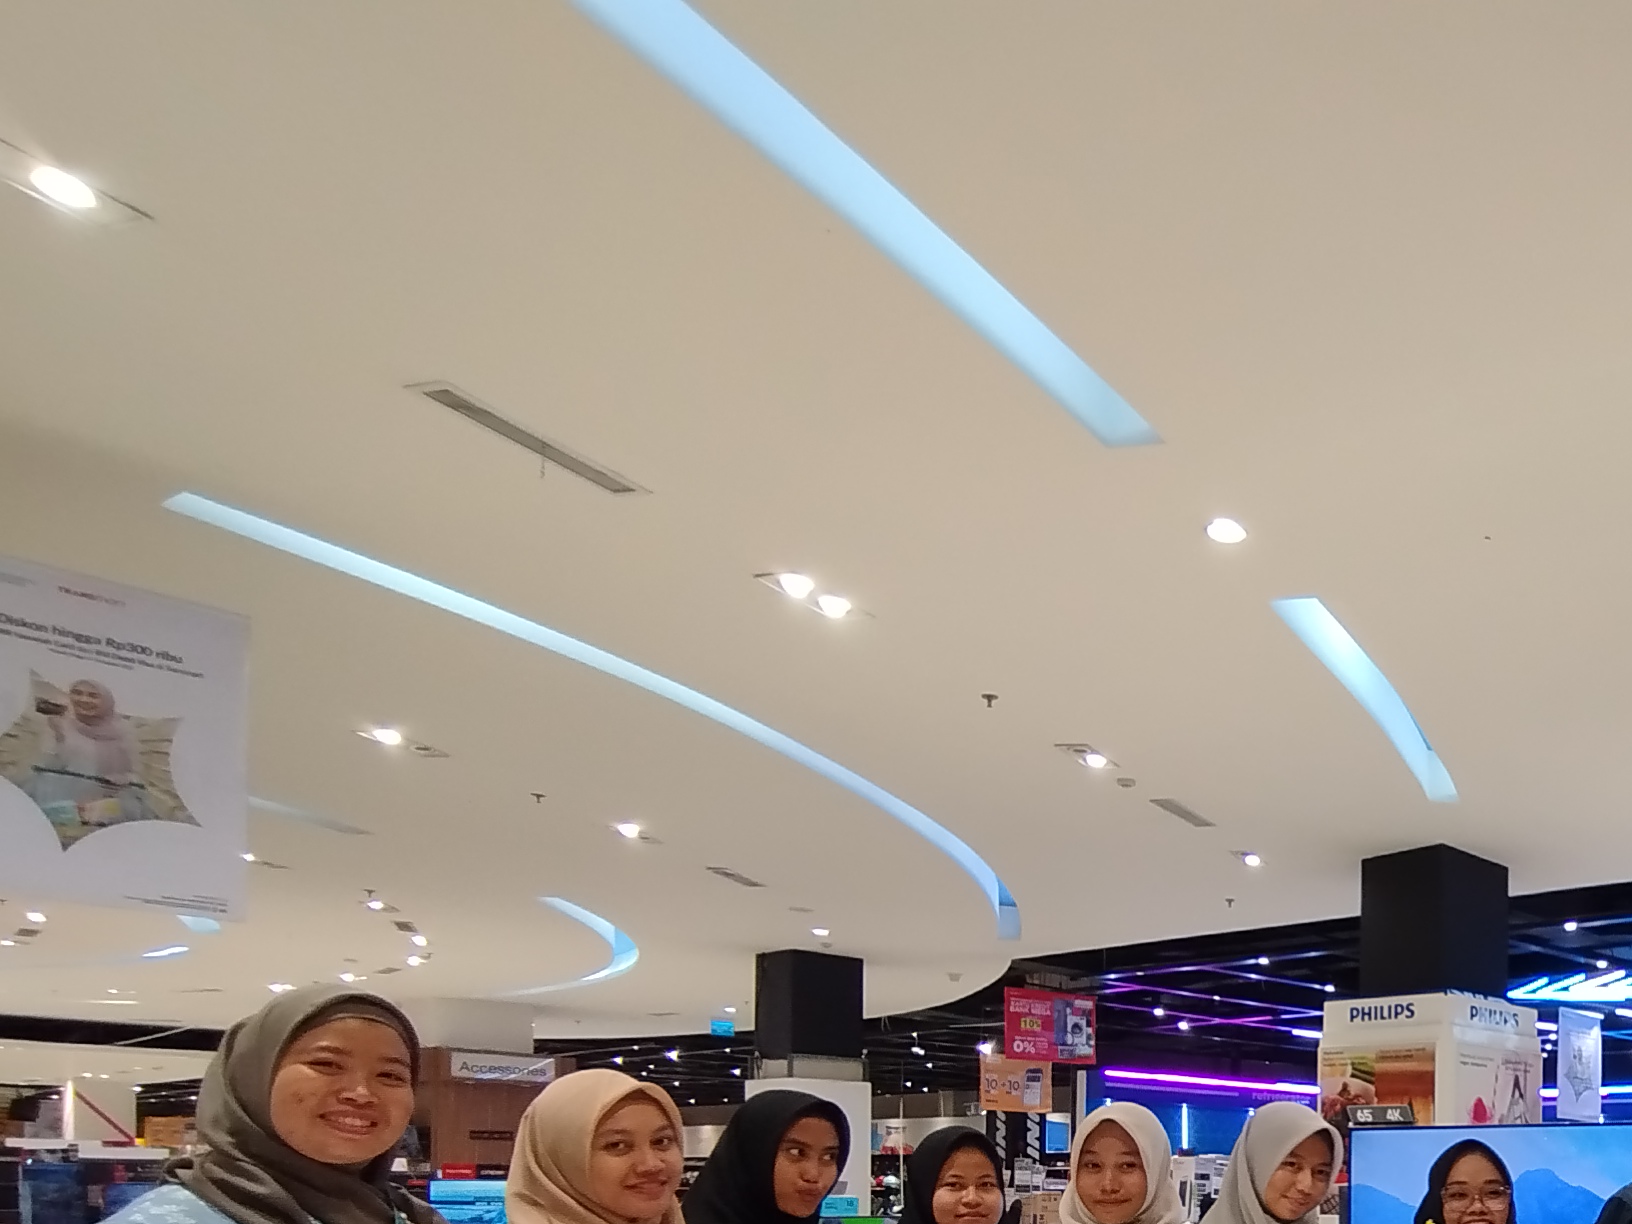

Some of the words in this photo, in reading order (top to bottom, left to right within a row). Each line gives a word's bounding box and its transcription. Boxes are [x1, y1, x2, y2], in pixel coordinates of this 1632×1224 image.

[105, 637, 153, 657] Rp300
[1350, 1003, 1415, 1022] PHILIPS
[1470, 1005, 1519, 1028] PHILIPS
[1013, 1040, 1035, 1054] 0%
[459, 1061, 547, 1077] Accessories
[985, 1078, 998, 1089] 10
[1008, 1080, 1020, 1091] 10
[1356, 1110, 1372, 1123] 65
[1386, 1108, 1403, 1122] 4K
